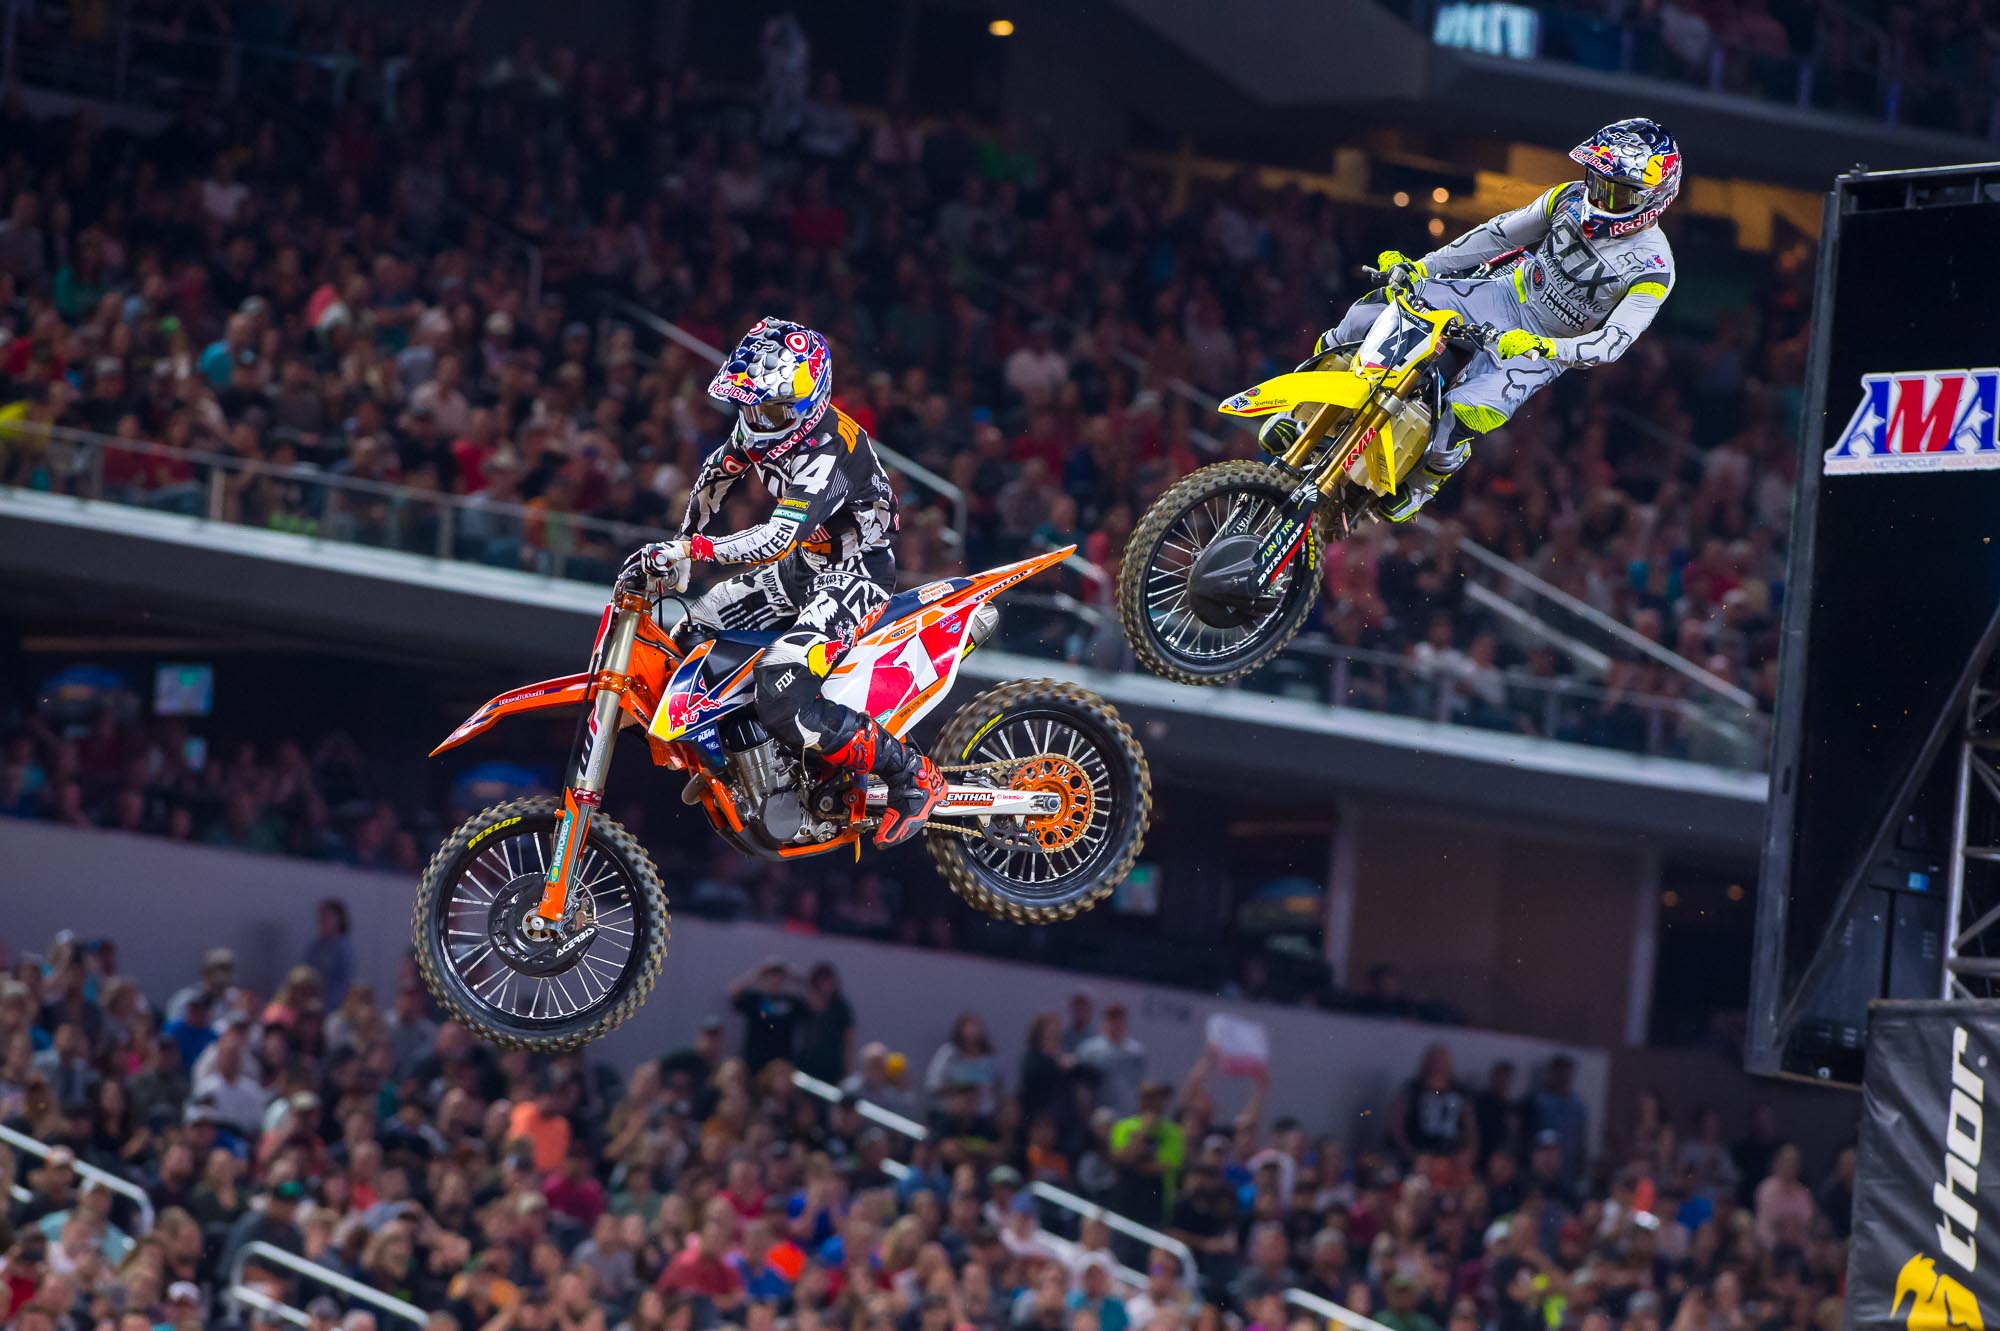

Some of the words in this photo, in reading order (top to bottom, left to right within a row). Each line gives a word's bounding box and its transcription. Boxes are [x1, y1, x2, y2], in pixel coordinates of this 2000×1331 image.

[1571, 150, 1590, 162] Red
[1588, 156, 1613, 175] Bull
[1610, 213, 1645, 237] Red
[1540, 295, 1584, 331] JOHN'S
[1546, 283, 1590, 325] JIMMY
[1565, 284, 1608, 314] Eagle
[711, 383, 732, 397] Red
[732, 387, 756, 405] Bull
[767, 431, 803, 460] Red
[801, 398, 828, 434] Bull
[1828, 370, 2000, 458] AMA
[1341, 427, 1377, 473] KYB
[793, 453, 837, 495] 4
[741, 523, 795, 563] SIXTEEN
[1257, 522, 1304, 586] DUNLOP
[975, 570, 1028, 602] DUNLOP
[775, 669, 796, 693] FOX
[892, 634, 940, 693] 1
[946, 793, 994, 801] ENTHAL
[467, 816, 522, 850] DUNLOP
[554, 819, 570, 867] MOTOREX
[556, 927, 595, 957] ACERBIS
[1933, 1026, 1984, 1273] thor
